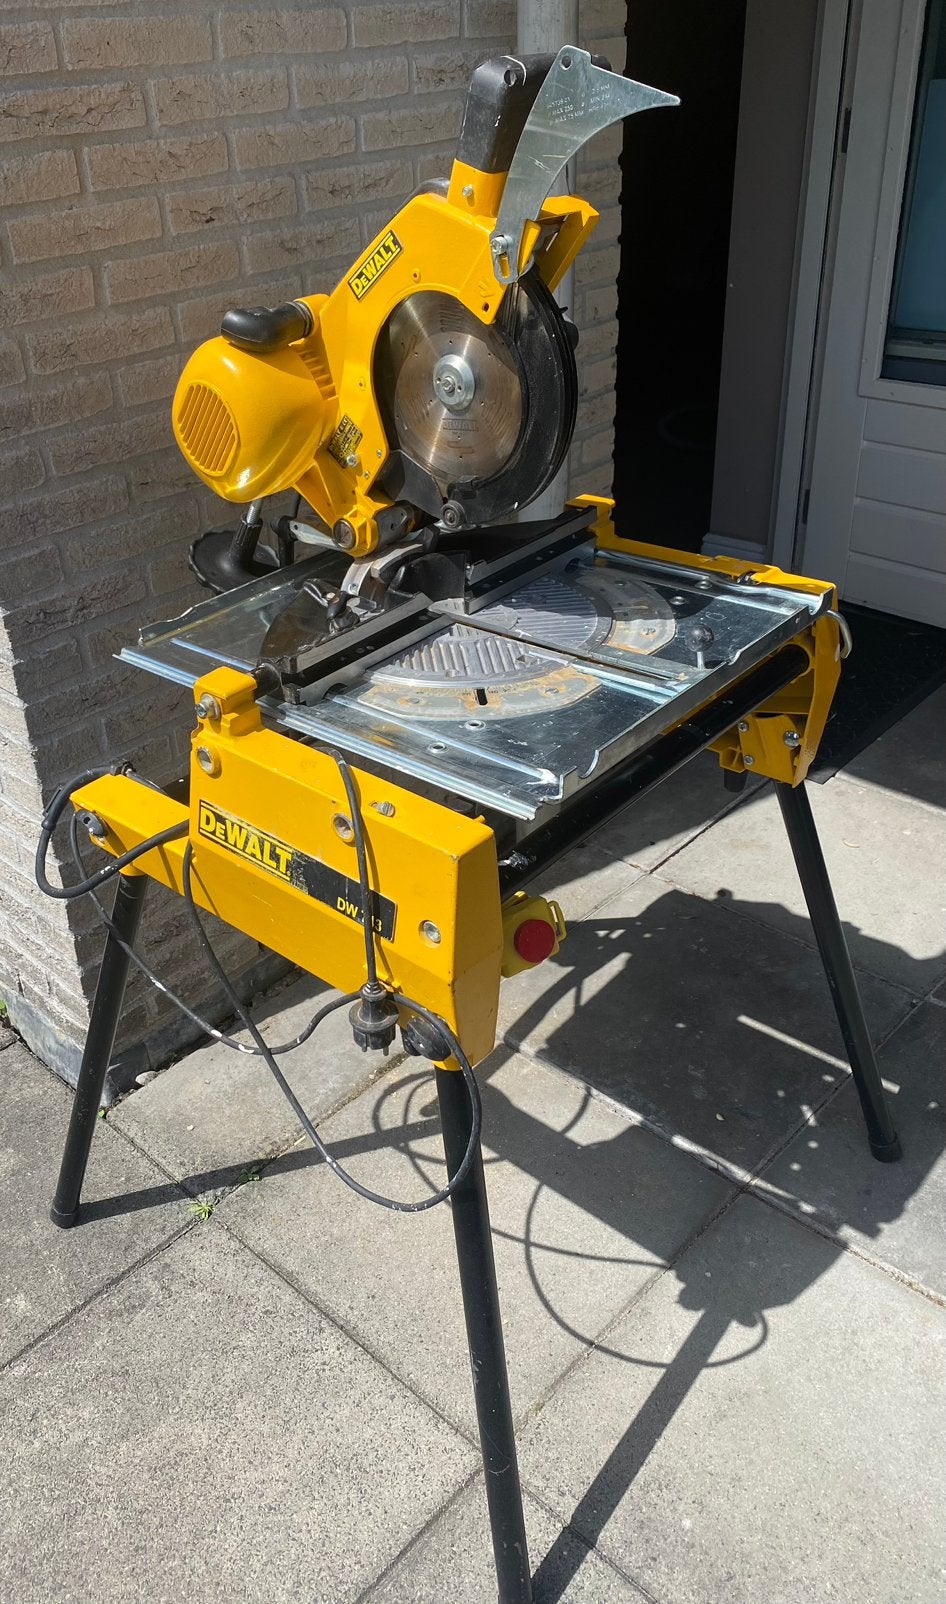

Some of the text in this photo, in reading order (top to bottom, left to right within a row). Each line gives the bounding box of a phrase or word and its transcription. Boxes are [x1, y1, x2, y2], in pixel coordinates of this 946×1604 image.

[350, 235, 397, 296] DEWALT
[200, 806, 292, 875] DEWALT
[337, 896, 358, 918] DW
